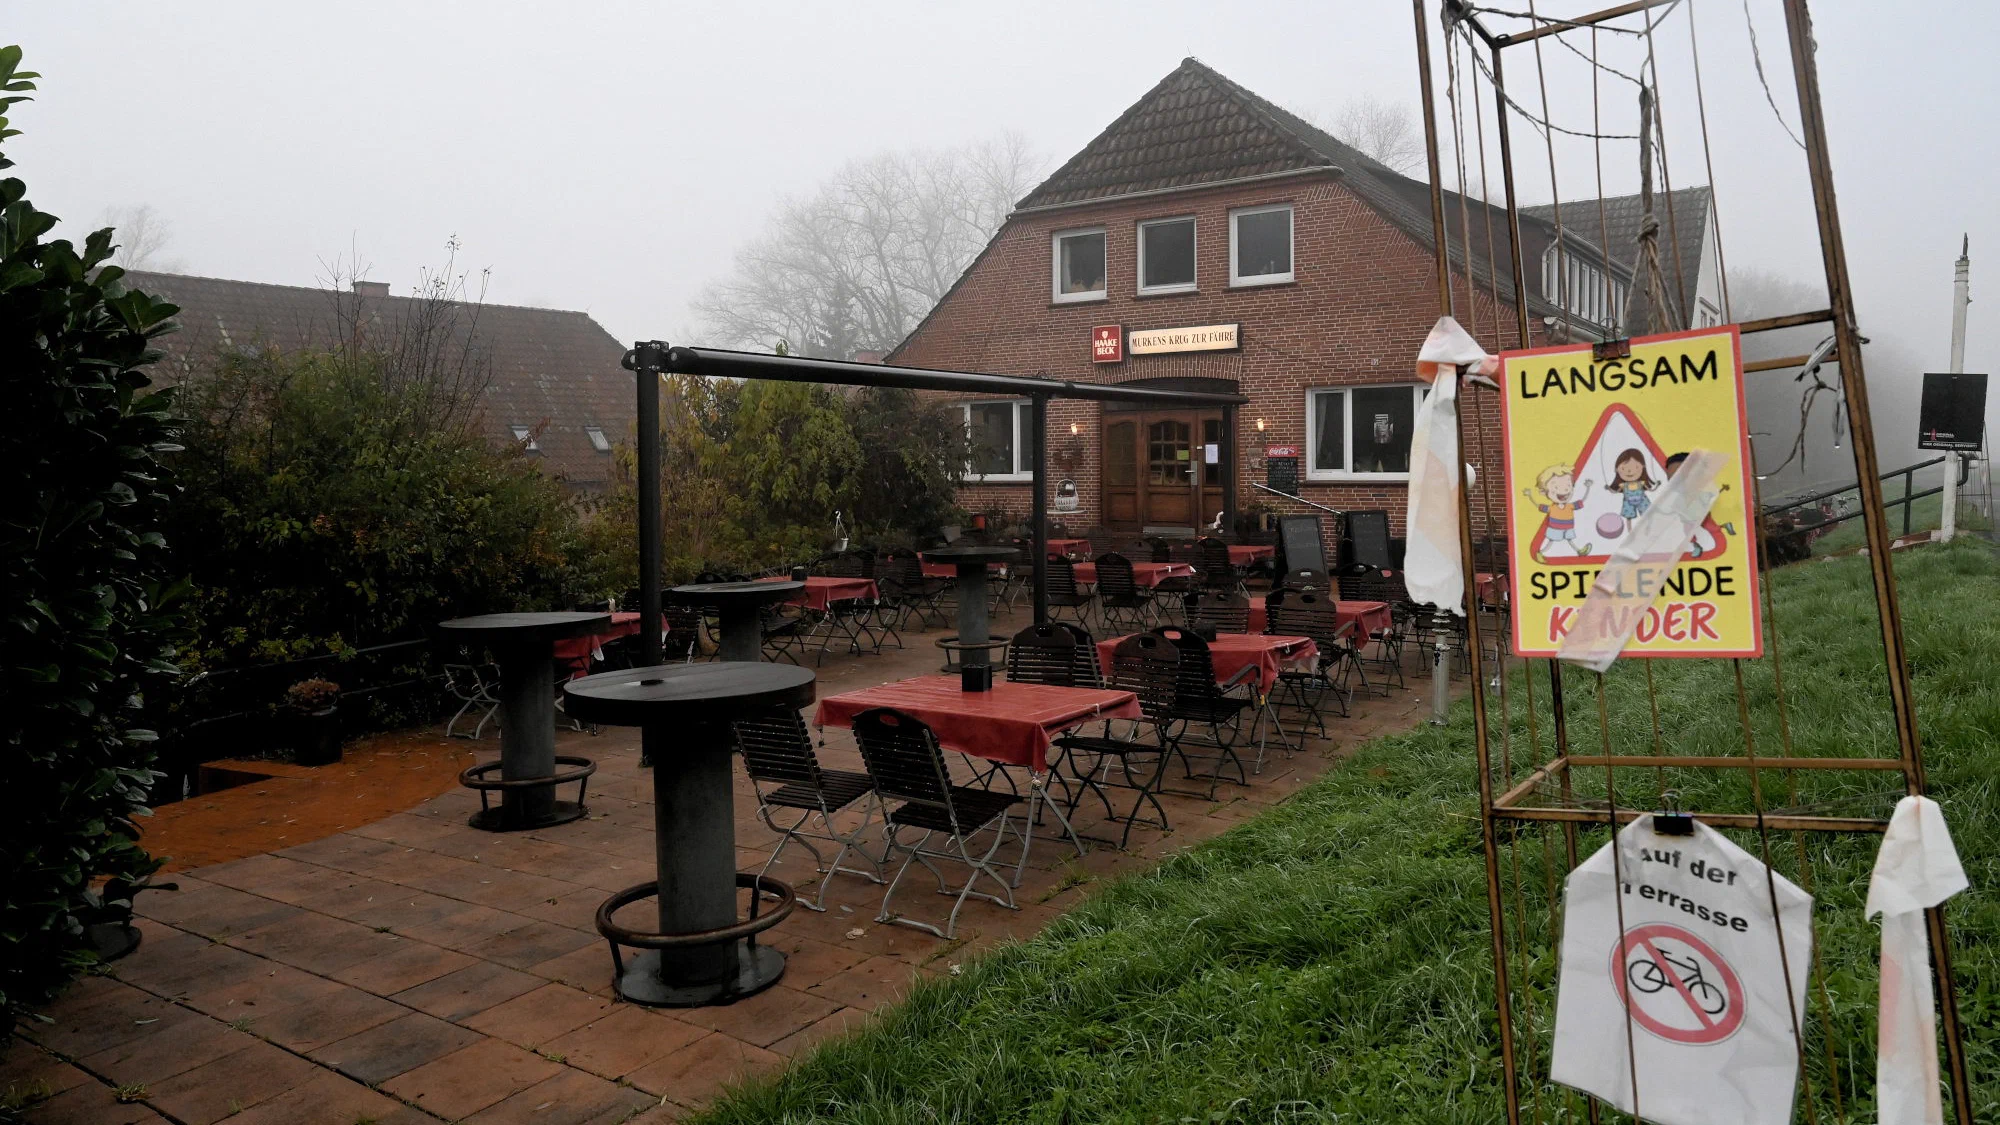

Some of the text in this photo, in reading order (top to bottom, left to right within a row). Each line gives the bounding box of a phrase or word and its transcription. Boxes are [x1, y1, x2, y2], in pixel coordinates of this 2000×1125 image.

[1094, 338, 1118, 348] HAAKE
[1096, 347, 1115, 356] BECK
[1132, 331, 1235, 348] MURKENS KRUG ZUR FÄHRE
[1519, 349, 1719, 400] LANGSAM
[1530, 565, 1736, 601] SPILENDE
[1548, 602, 1720, 643] KNDER
[1689, 858, 1738, 886] der
